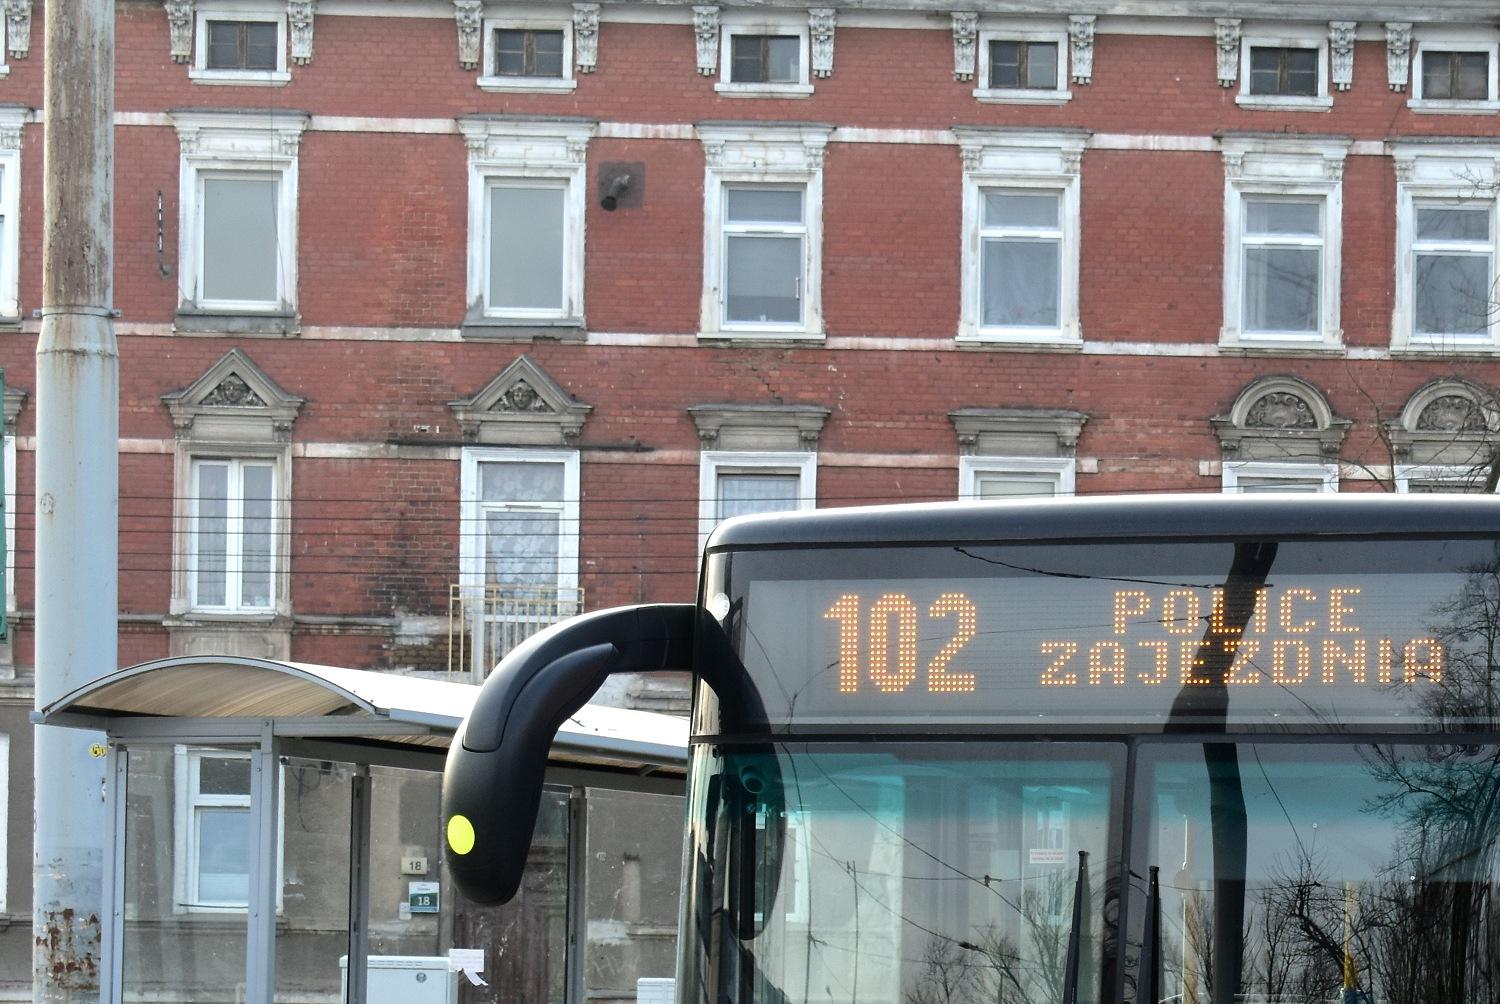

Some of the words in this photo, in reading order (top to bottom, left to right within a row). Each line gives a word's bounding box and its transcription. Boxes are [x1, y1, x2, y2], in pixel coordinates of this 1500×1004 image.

[1114, 588, 1361, 634] POLICE
[824, 593, 976, 692] 102
[1041, 639, 1443, 684] ZAJEZDNIA
[409, 861, 422, 871] 18
[418, 896, 430, 906] 18
